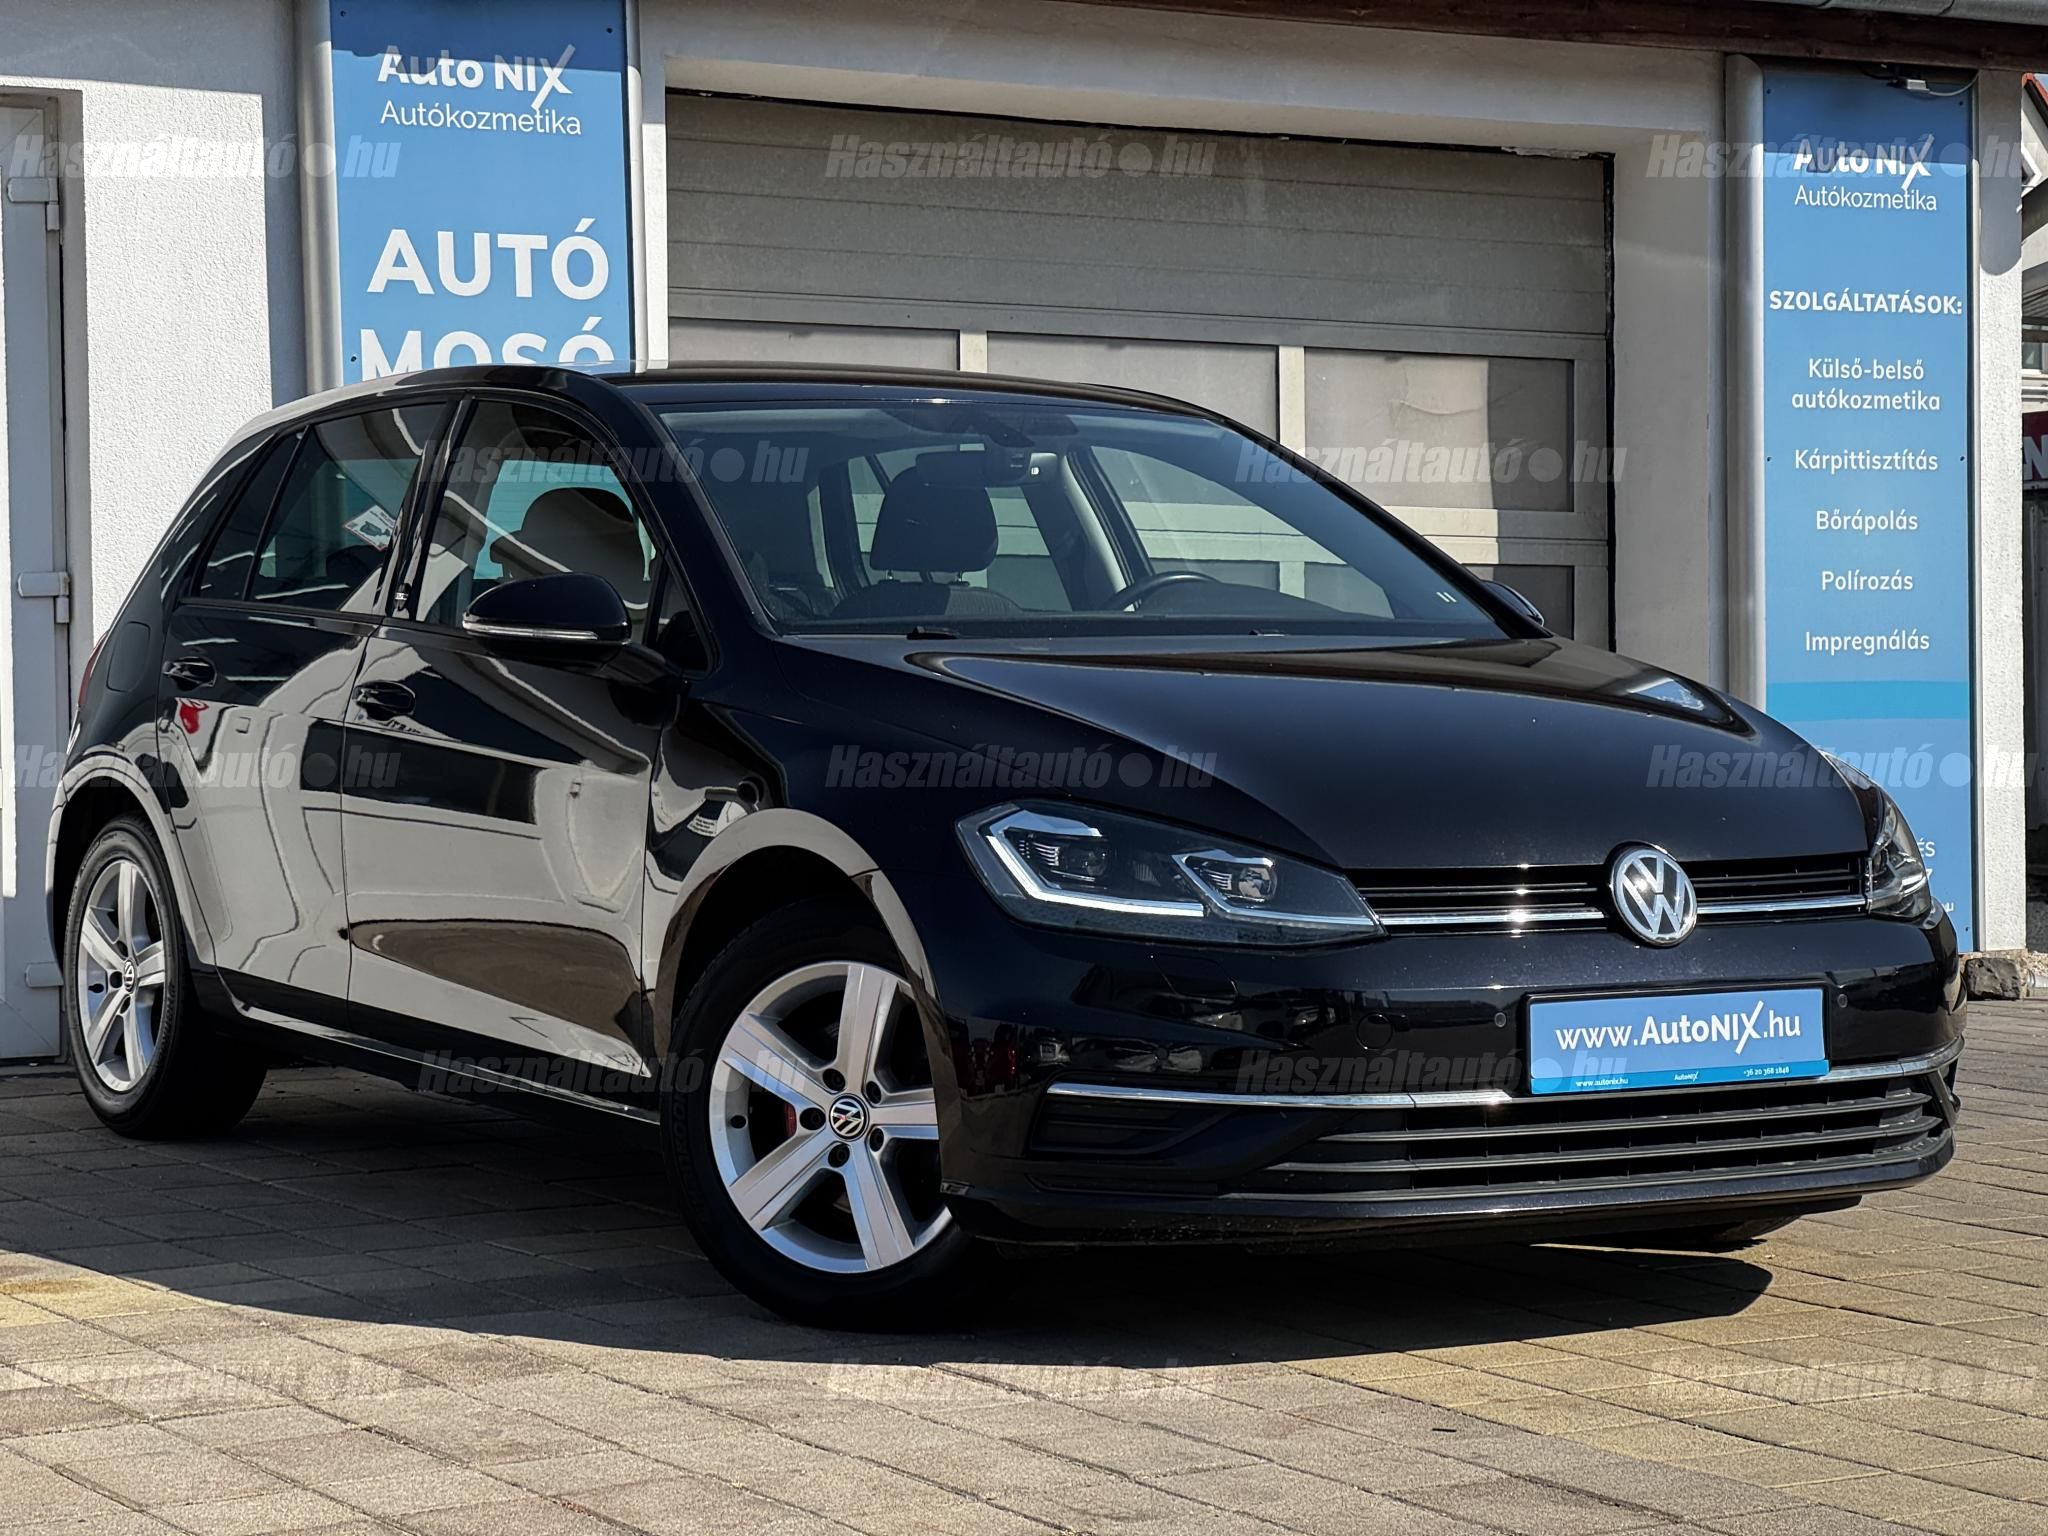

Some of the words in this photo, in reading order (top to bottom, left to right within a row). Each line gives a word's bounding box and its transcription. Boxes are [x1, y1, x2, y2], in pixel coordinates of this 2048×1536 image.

[377, 45, 484, 88] Auto
[494, 44, 576, 110] NIX
[380, 100, 581, 135] Autókozmetika
[1793, 138, 1870, 174] Auto
[1876, 134, 1935, 190] NIX
[1794, 184, 1937, 211] Autókozmetika
[367, 217, 609, 300] AUTÓ
[1769, 287, 1963, 315] SZOLGÁLTATÁSOK:
[1809, 358, 1925, 381] Külső-belső
[1792, 388, 1941, 411] autókozmetika
[1795, 448, 1938, 475] Kárpittisztítás
[1816, 508, 1918, 535] Bőrápolás
[1821, 570, 1914, 592] Polírozás
[1805, 629, 1930, 656] Impregnálás
[1555, 1000, 1801, 1055] www.AutoNIX.hu
